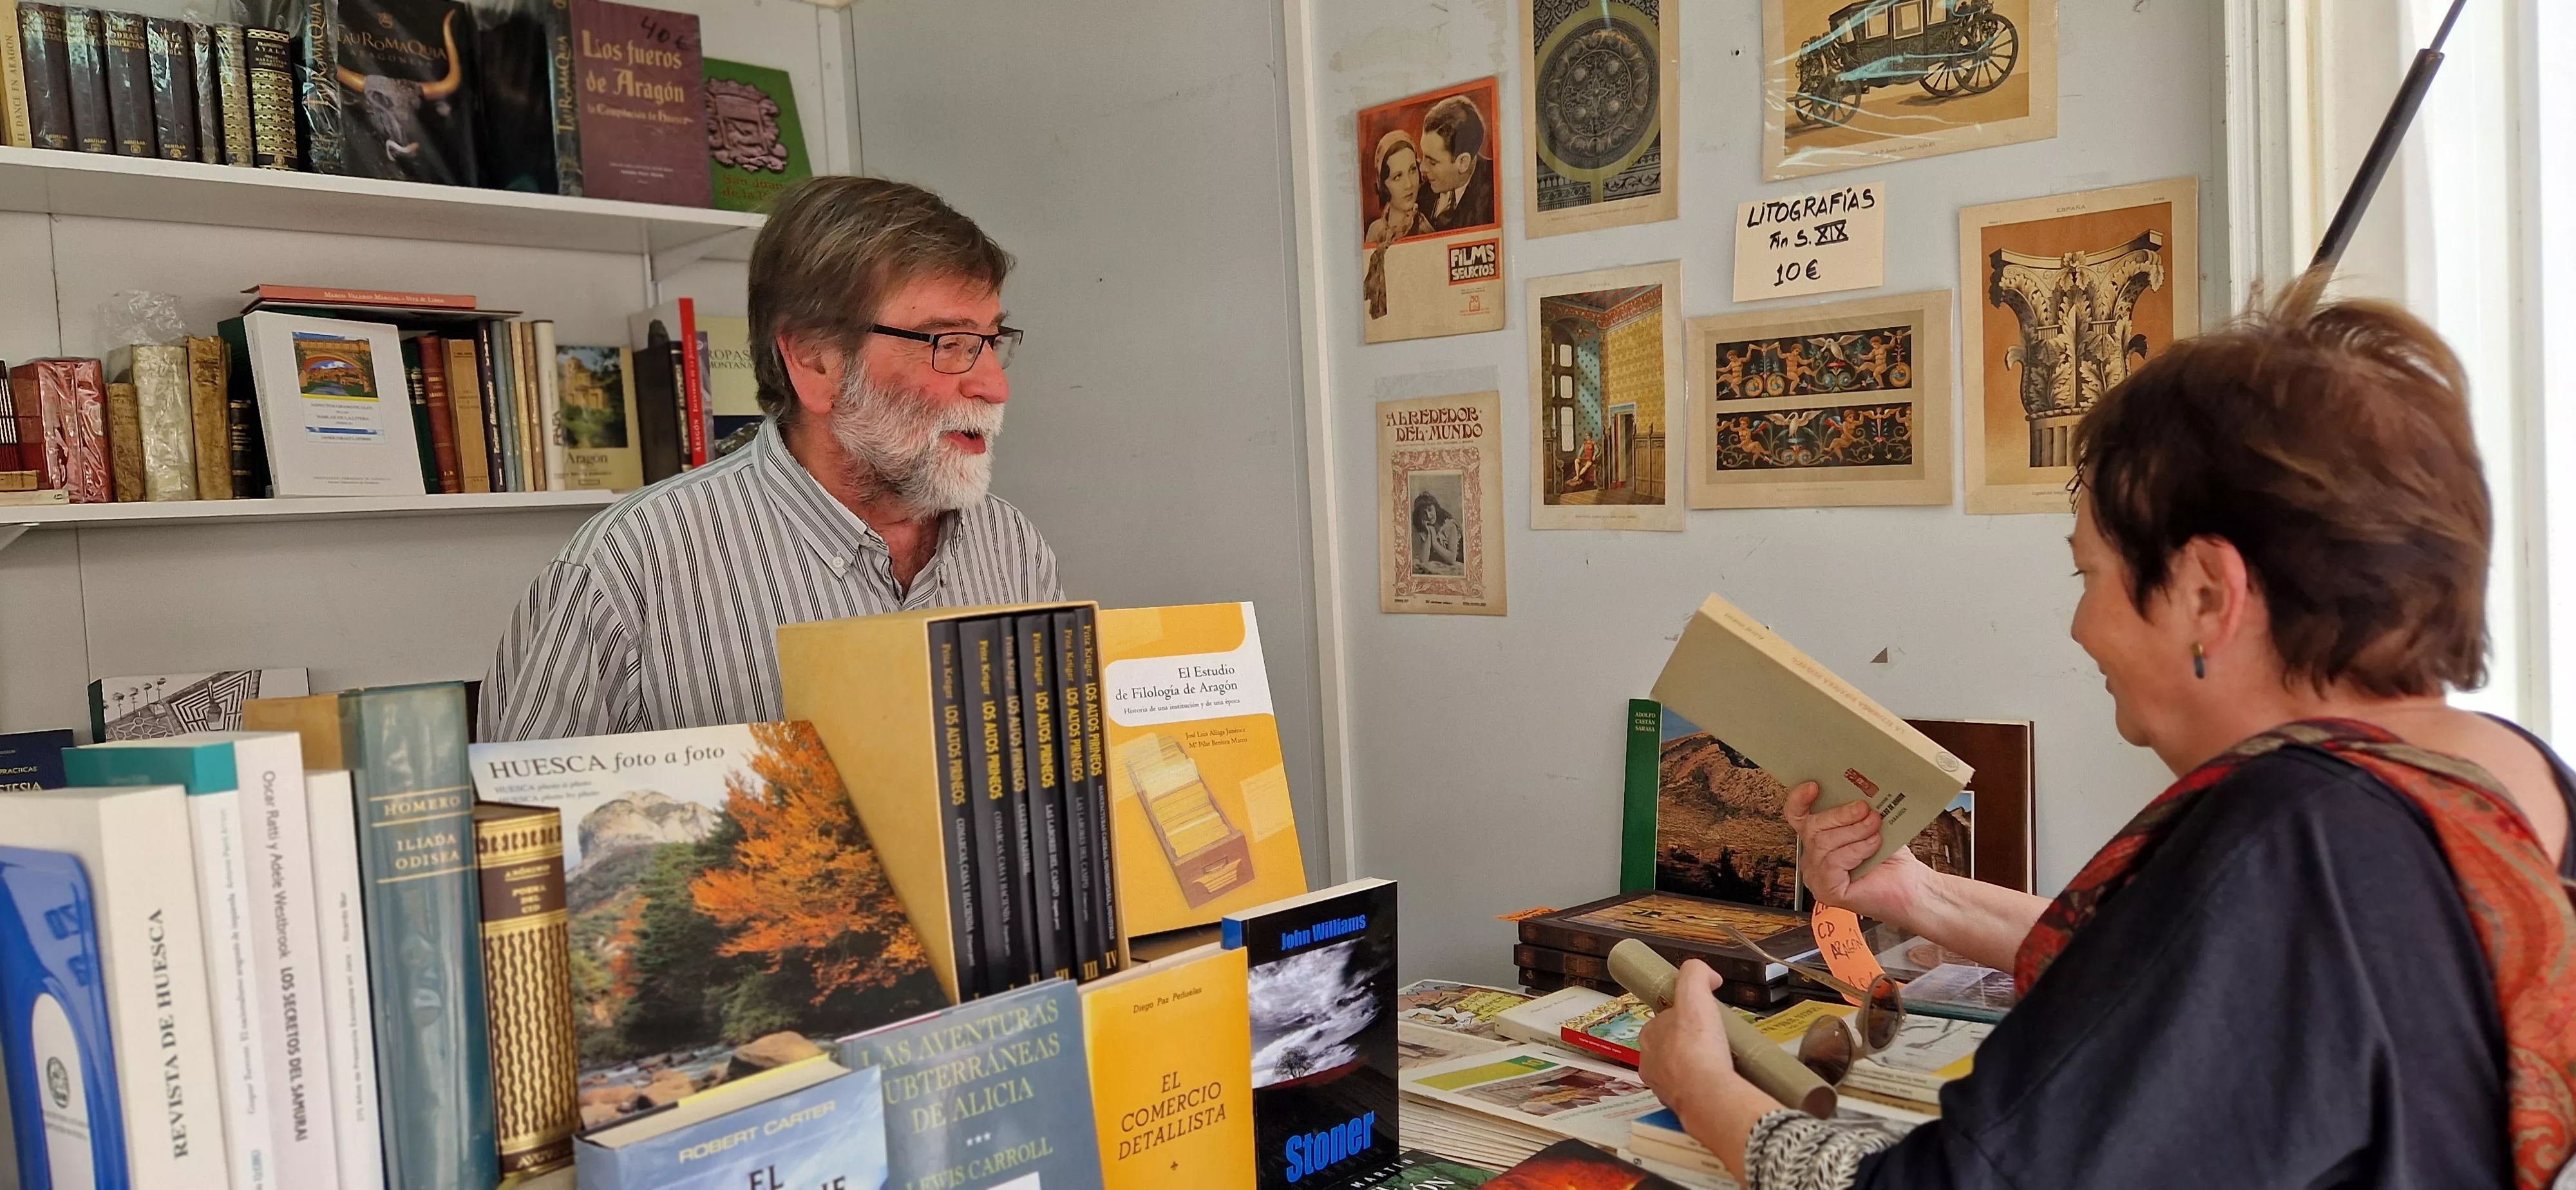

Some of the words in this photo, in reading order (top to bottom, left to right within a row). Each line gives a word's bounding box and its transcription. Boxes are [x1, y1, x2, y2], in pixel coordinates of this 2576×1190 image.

[641, 16, 670, 44] 40
[254, 46, 286, 55] AYALA
[582, 30, 623, 61] Los
[627, 40, 682, 69] fueros
[12, 80, 19, 91] EN
[585, 70, 607, 93] de
[614, 68, 685, 106] Aragón
[14, 97, 24, 127] DANCE
[17, 132, 25, 141] EL
[1747, 187, 1875, 228] LITOGRAFÍAS
[1814, 219, 1850, 247] XIX
[1450, 244, 1495, 269] FILMS
[1452, 263, 1495, 281] SELECTOS
[1396, 426, 1425, 442] DEL
[1428, 422, 1483, 441] MUNDO
[1083, 625, 1092, 645] Fritz
[1177, 666, 1190, 679] El
[1195, 664, 1235, 677] Estudio
[1035, 692, 1049, 711] LOS
[1066, 688, 1079, 705] LOS
[1084, 683, 1098, 701] LOS
[1115, 688, 1128, 701] de
[1132, 685, 1180, 701] Filología
[1184, 683, 1196, 694] de
[1199, 679, 1238, 696] Aragón
[1170, 701, 1199, 710] institución
[1225, 698, 1240, 706] época
[981, 701, 996, 721] LOS
[1067, 708, 1081, 737] ALTOS
[1086, 703, 1100, 732] ALTOS
[984, 722, 999, 753] ALTOS
[1037, 713, 1052, 742] ALTOS
[1185, 732, 1196, 741] José
[489, 753, 606, 779] HUESCA
[613, 751, 656, 773] foto
[665, 752, 677, 764] a
[684, 746, 725, 766] foto
[1040, 744, 1055, 788] PIRINEOS
[1070, 739, 1084, 782] PIRINEOS
[1089, 733, 1103, 776] PIRINEOS
[262, 770, 276, 807] Oscar
[987, 754, 1003, 799] PIRINEOS
[384, 796, 460, 817] HOMERO
[270, 853, 284, 888] Adele
[395, 851, 460, 871] ODISEA
[274, 891, 292, 959] Westbrook
[1281, 929, 1311, 951] John
[1312, 914, 1367, 942] Williams
[1817, 921, 1835, 940] CD
[147, 909, 173, 1009] HUESCA
[1083, 960, 1099, 980] III
[1104, 950, 1117, 969] IV
[280, 967, 295, 990] LOS
[1133, 1000, 1154, 1014] Diego
[1157, 996, 1169, 1006] Paz
[1172, 987, 1202, 1002] Peñuelas
[159, 1014, 177, 1049] DE
[282, 993, 301, 1056] SECRETOS
[861, 1038, 912, 1072] LAS
[917, 999, 1059, 1060] AVENTURAS
[288, 1057, 303, 1082] DEL
[884, 1032, 1060, 1106] UBTERRÁNEAS
[1161, 1072, 1181, 1093] EL
[164, 1055, 189, 1160] REVISTA
[290, 1084, 308, 1142] SAMURAI
[910, 1100, 947, 1134] DE
[951, 1077, 1035, 1122] ALICIA
[1121, 1081, 1222, 1133] COMERCIO
[679, 1126, 759, 1163] ROBERT
[763, 1099, 836, 1135] CARTER
[1118, 1104, 1227, 1160] DETALLISTA
[1285, 1110, 1376, 1184] Stoner
[905, 1164, 965, 1190] LEWIS
[968, 1137, 1053, 1180] CARROLL
[1350, 1158, 1416, 1188] MARTIN
